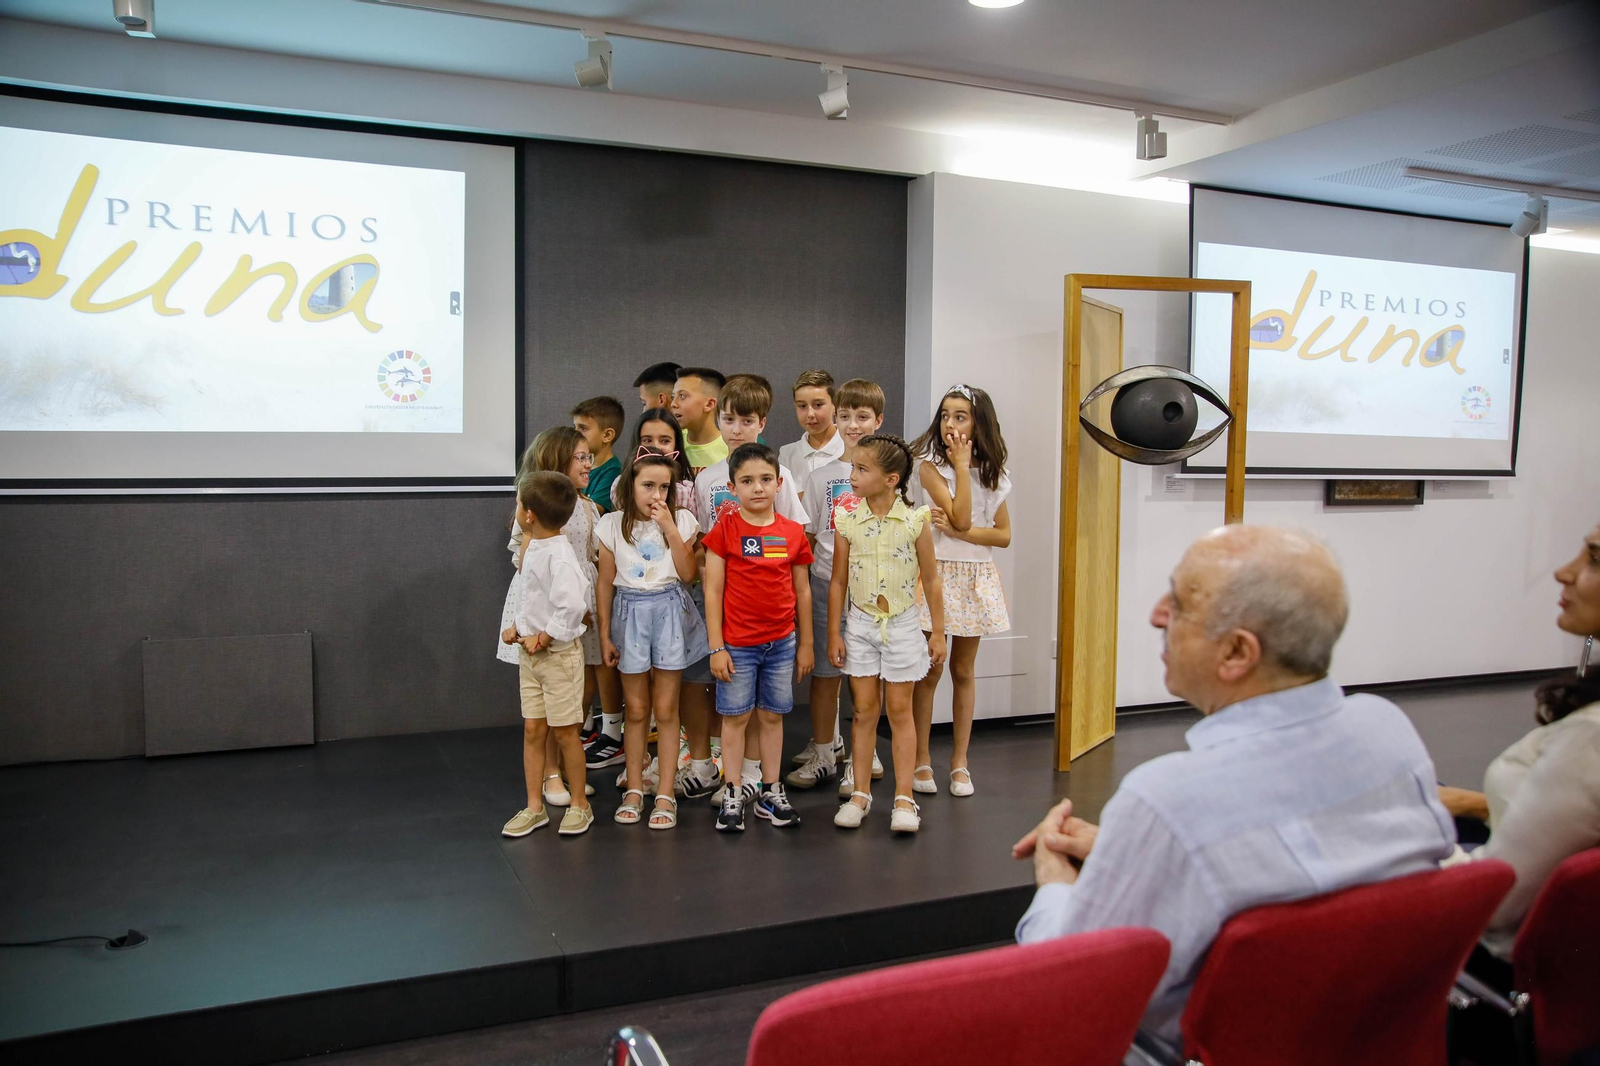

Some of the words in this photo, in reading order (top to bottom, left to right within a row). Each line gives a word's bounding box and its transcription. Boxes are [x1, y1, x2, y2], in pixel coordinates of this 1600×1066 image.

[0, 163, 383, 332] duna
[105, 197, 378, 242] PREMIOS
[1250, 269, 1466, 375] duna
[1319, 290, 1466, 318] PREMIOS
